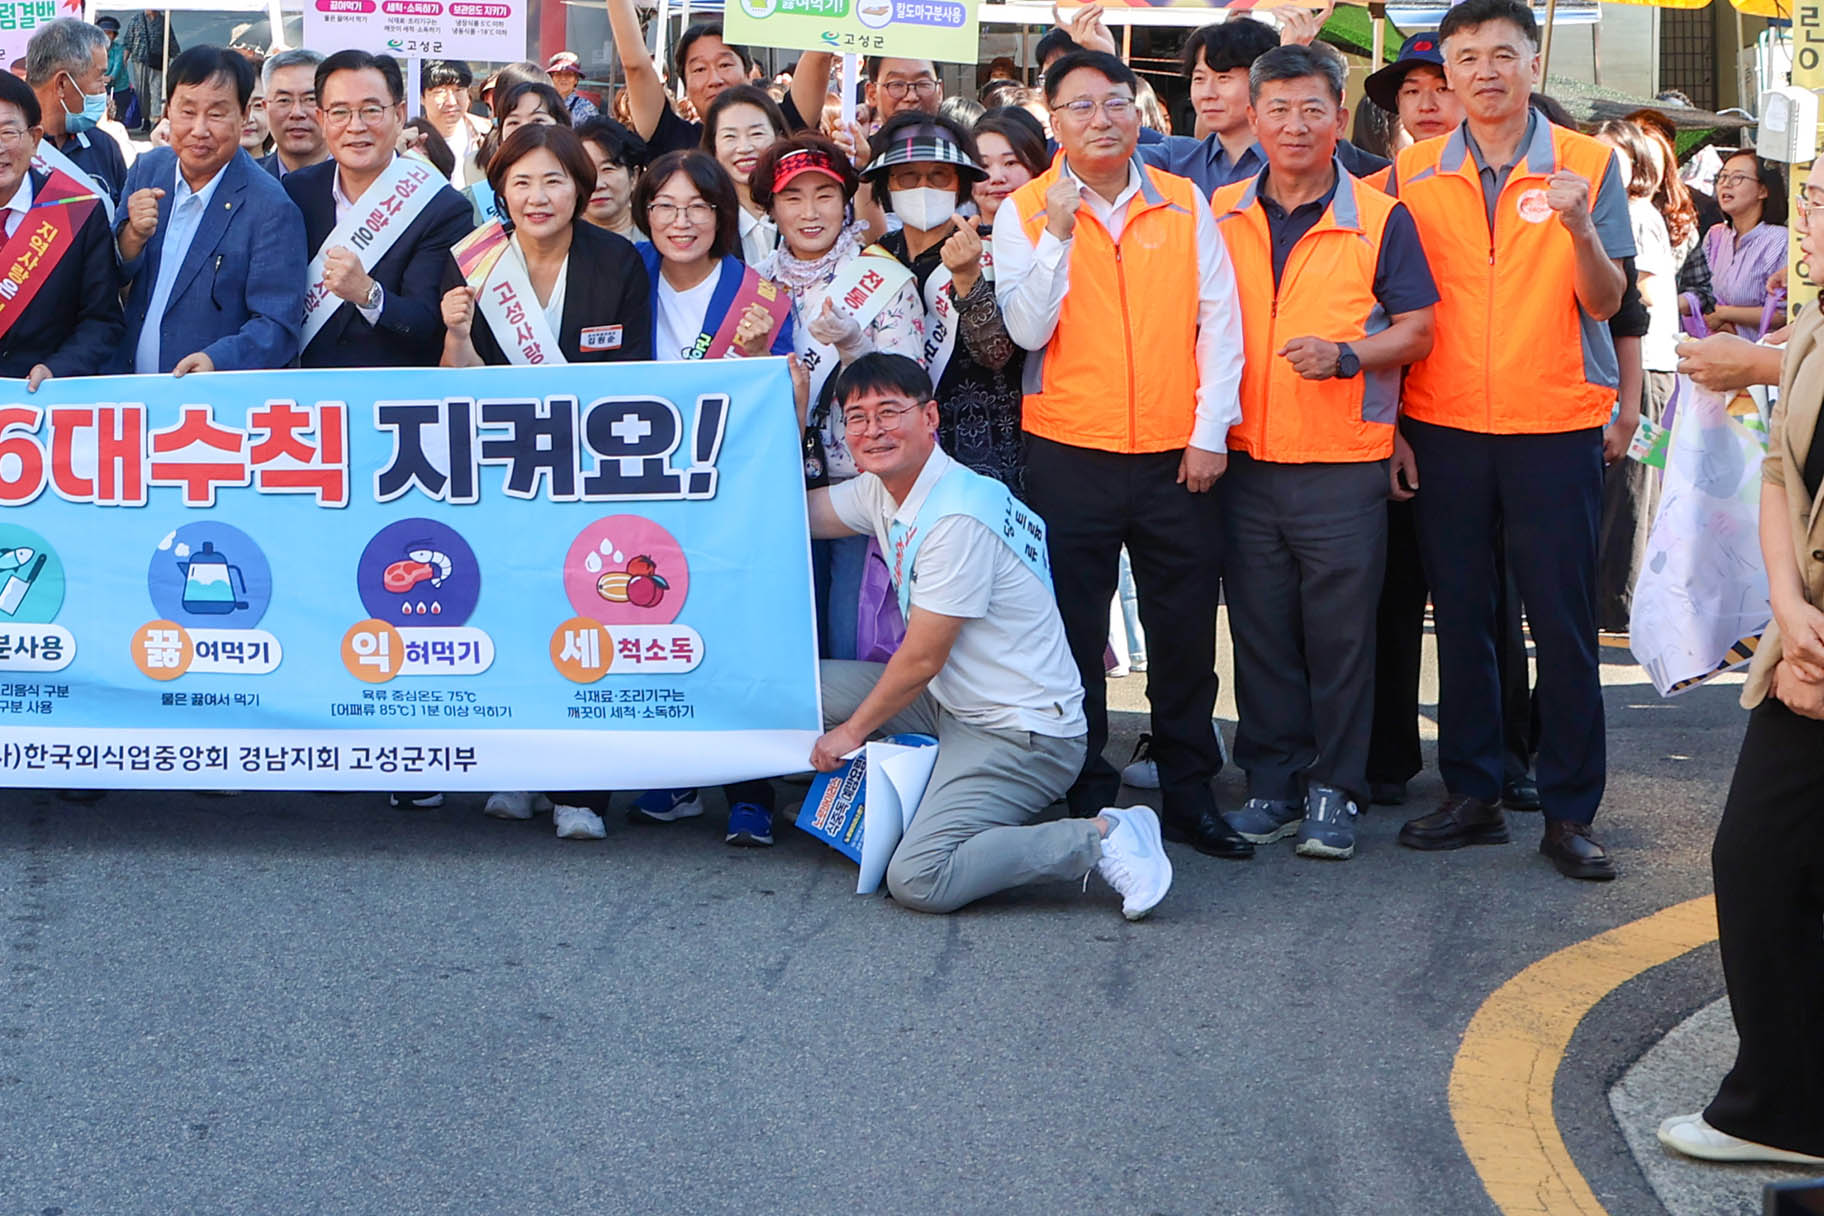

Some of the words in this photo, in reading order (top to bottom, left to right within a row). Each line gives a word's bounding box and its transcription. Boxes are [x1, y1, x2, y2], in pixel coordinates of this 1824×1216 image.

[407, 40, 443, 53] 고성군
[844, 33, 885, 49] 고성군
[354, 165, 430, 250] 고성사랑은
[376, 393, 729, 506] 지켜요!
[43, 684, 69, 698] 구분
[362, 690, 388, 703] 육류
[391, 690, 443, 703] 중심온도
[161, 692, 187, 706] 물은
[190, 692, 230, 706] 끓여서
[233, 692, 260, 707] 먹기
[26, 700, 53, 714] 사용
[421, 704, 440, 717] 1분
[443, 704, 469, 718] 이상
[472, 705, 512, 718] 익히기
[567, 705, 606, 719] 깨끗이
[239, 741, 341, 772] 경남지회
[349, 746, 478, 773] 고성군지부
